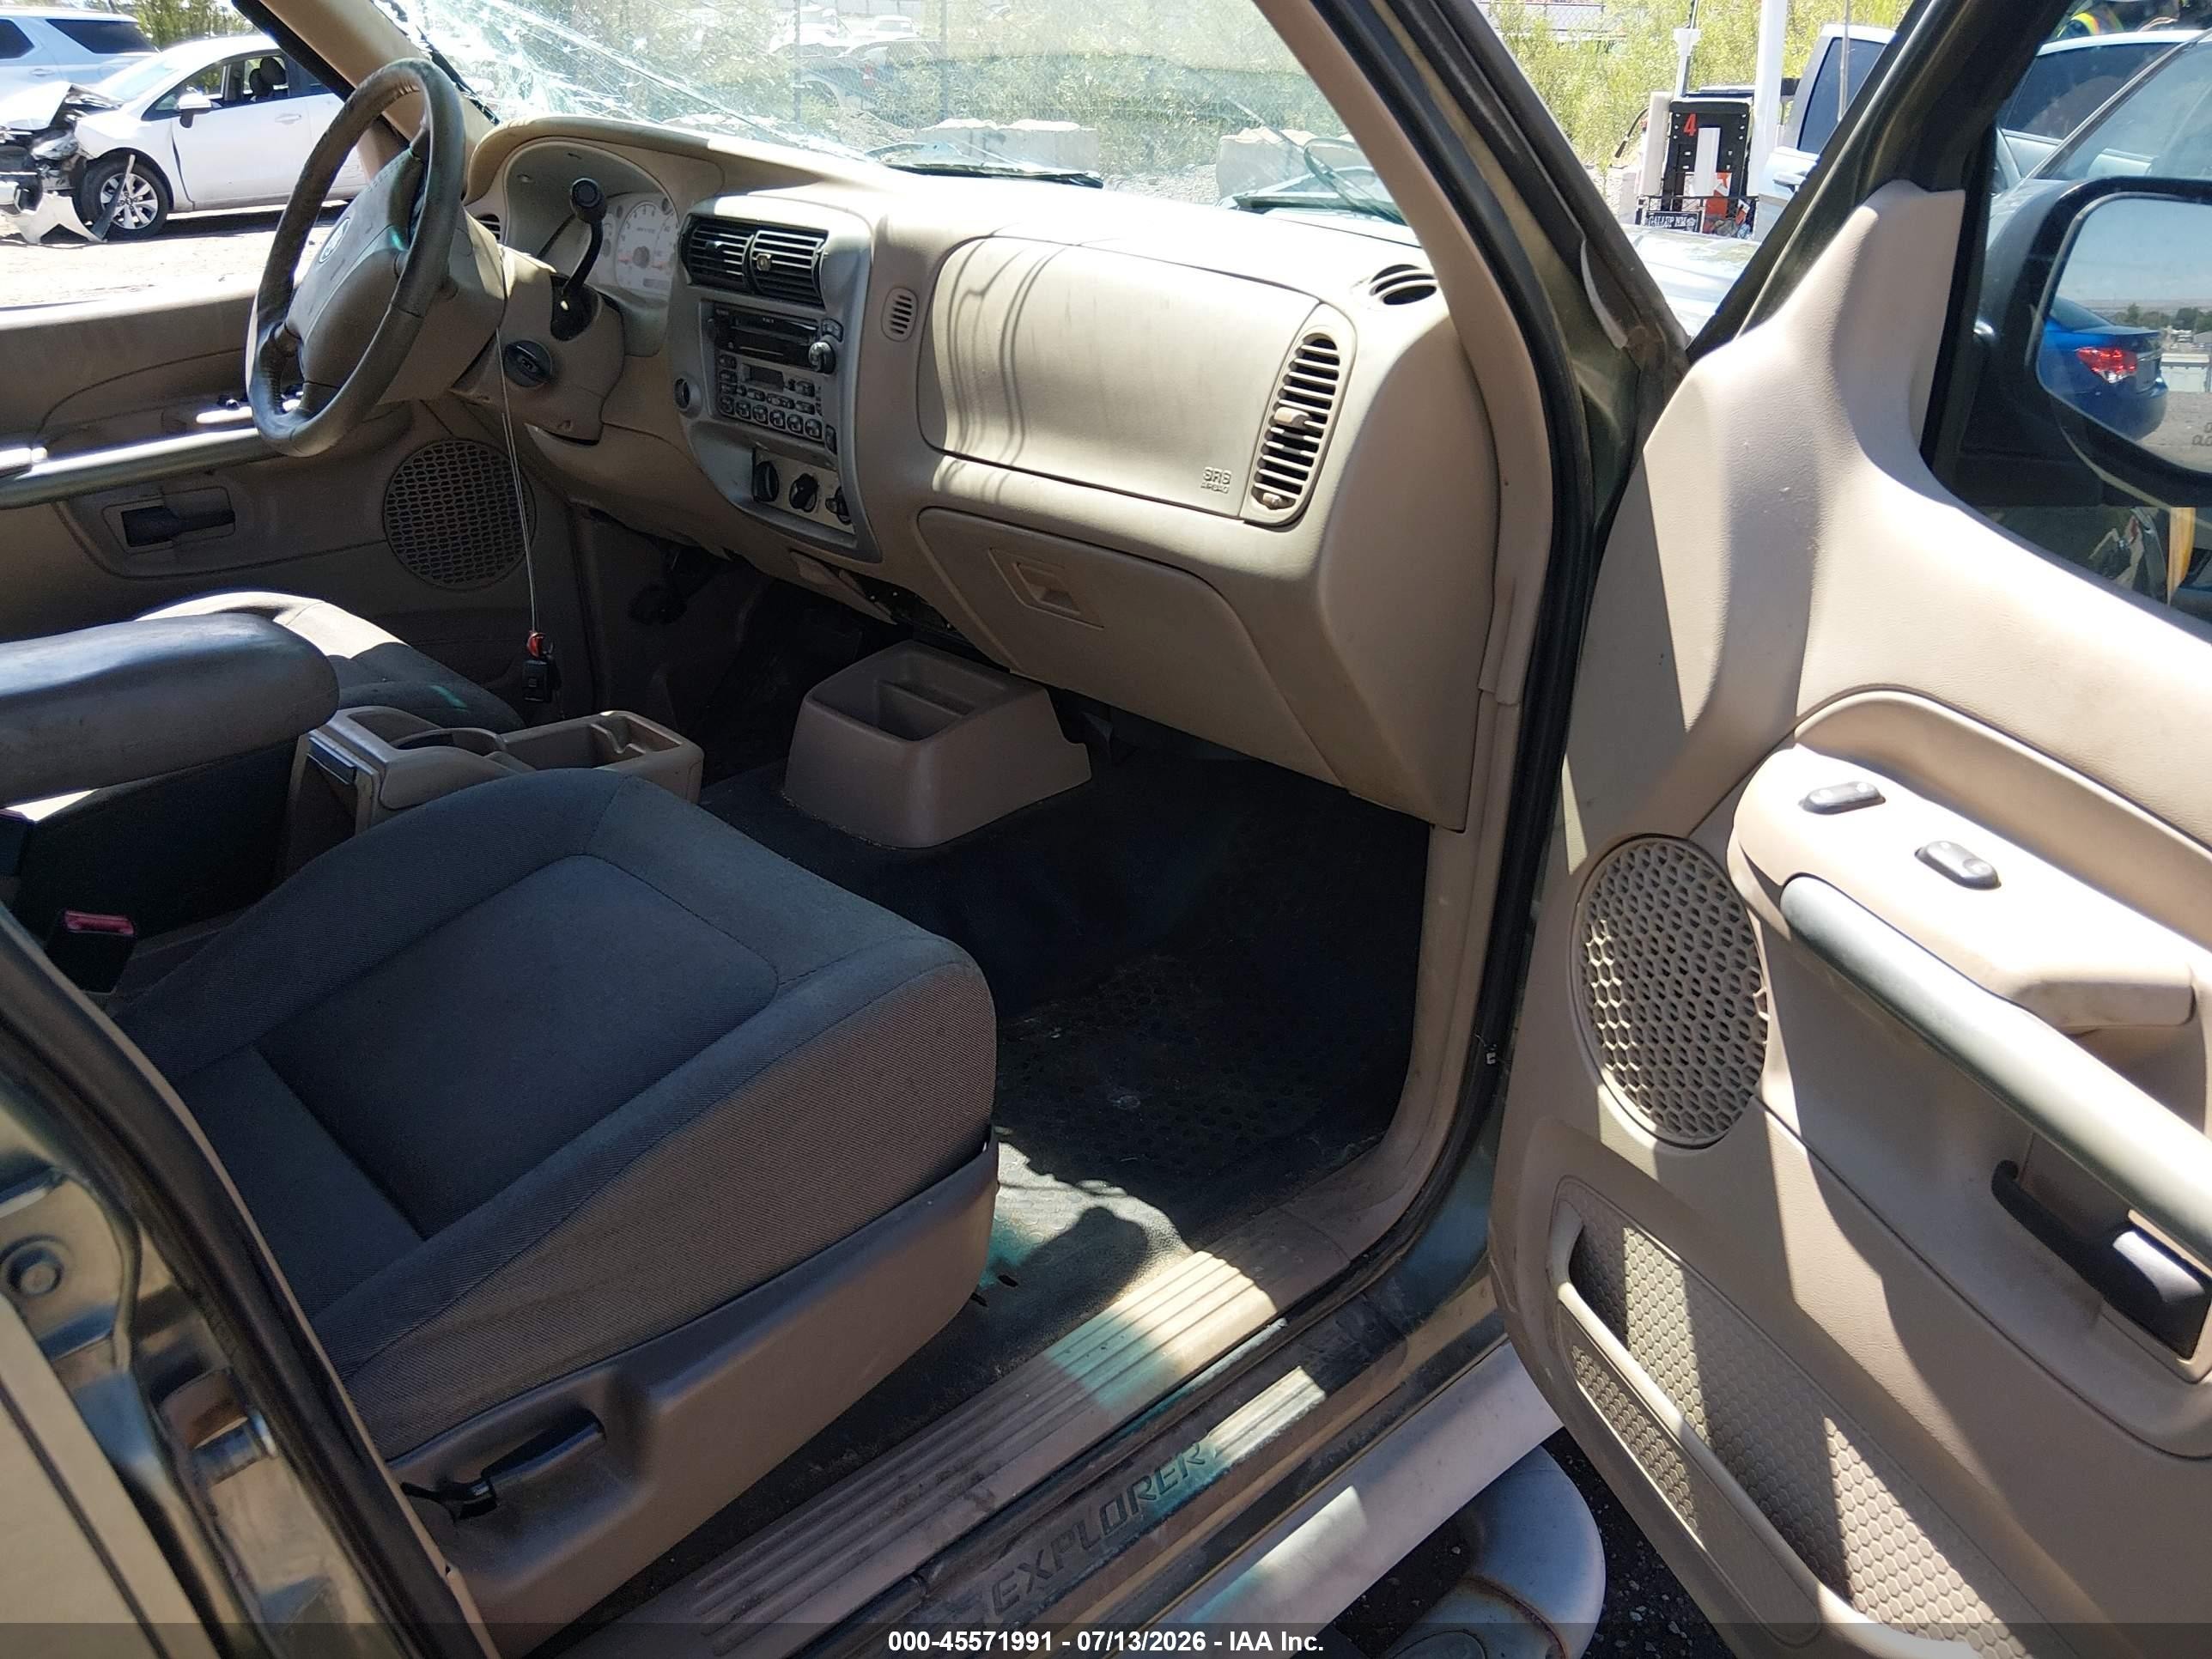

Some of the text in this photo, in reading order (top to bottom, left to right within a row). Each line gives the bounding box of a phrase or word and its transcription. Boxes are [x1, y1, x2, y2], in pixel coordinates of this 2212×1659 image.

[1683, 112, 1697, 137] 4
[1203, 467, 1231, 485] SRS
[991, 1442, 1206, 1616] EXPLORER
